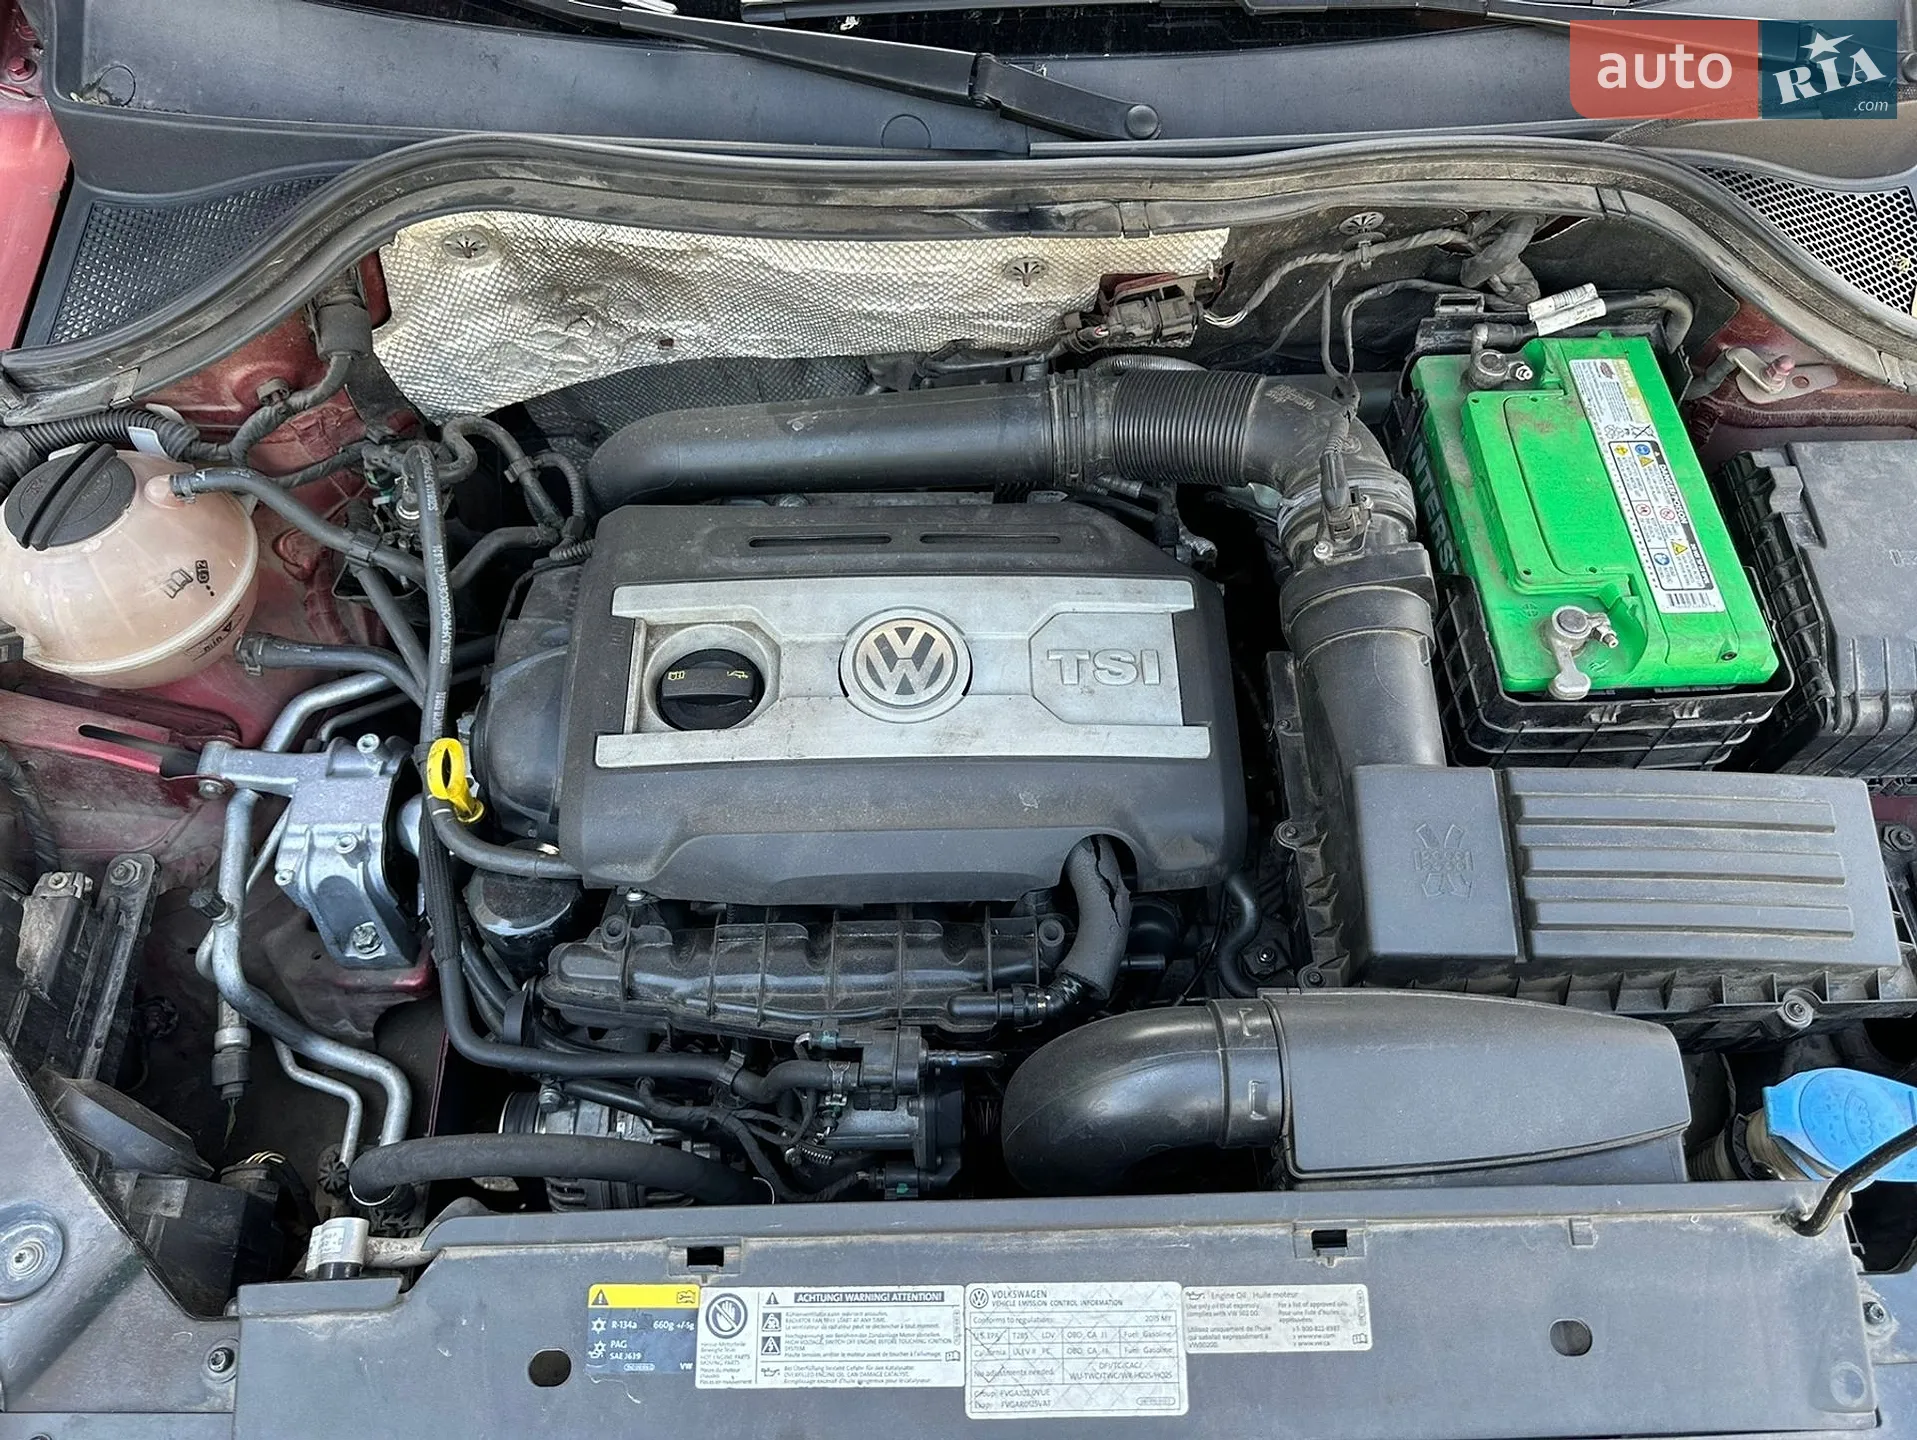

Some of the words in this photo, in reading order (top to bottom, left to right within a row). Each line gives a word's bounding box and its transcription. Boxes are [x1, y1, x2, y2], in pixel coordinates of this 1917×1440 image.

[1047, 649, 1161, 686] TSI
[797, 1293, 842, 1302] ACHTUNG!
[845, 1292, 890, 1302] WARNING!
[892, 1292, 942, 1301] ATTENTION!
[992, 1290, 1048, 1298] VOLKSWAGEN
[1211, 1292, 1234, 1300] Engine
[612, 1320, 637, 1329] R-134a
[653, 1320, 674, 1331] 660g
[610, 1340, 627, 1348] PAG
[1142, 1346, 1172, 1354] Gasoline
[610, 1352, 623, 1360] SAE
[680, 1362, 693, 1370] VW
